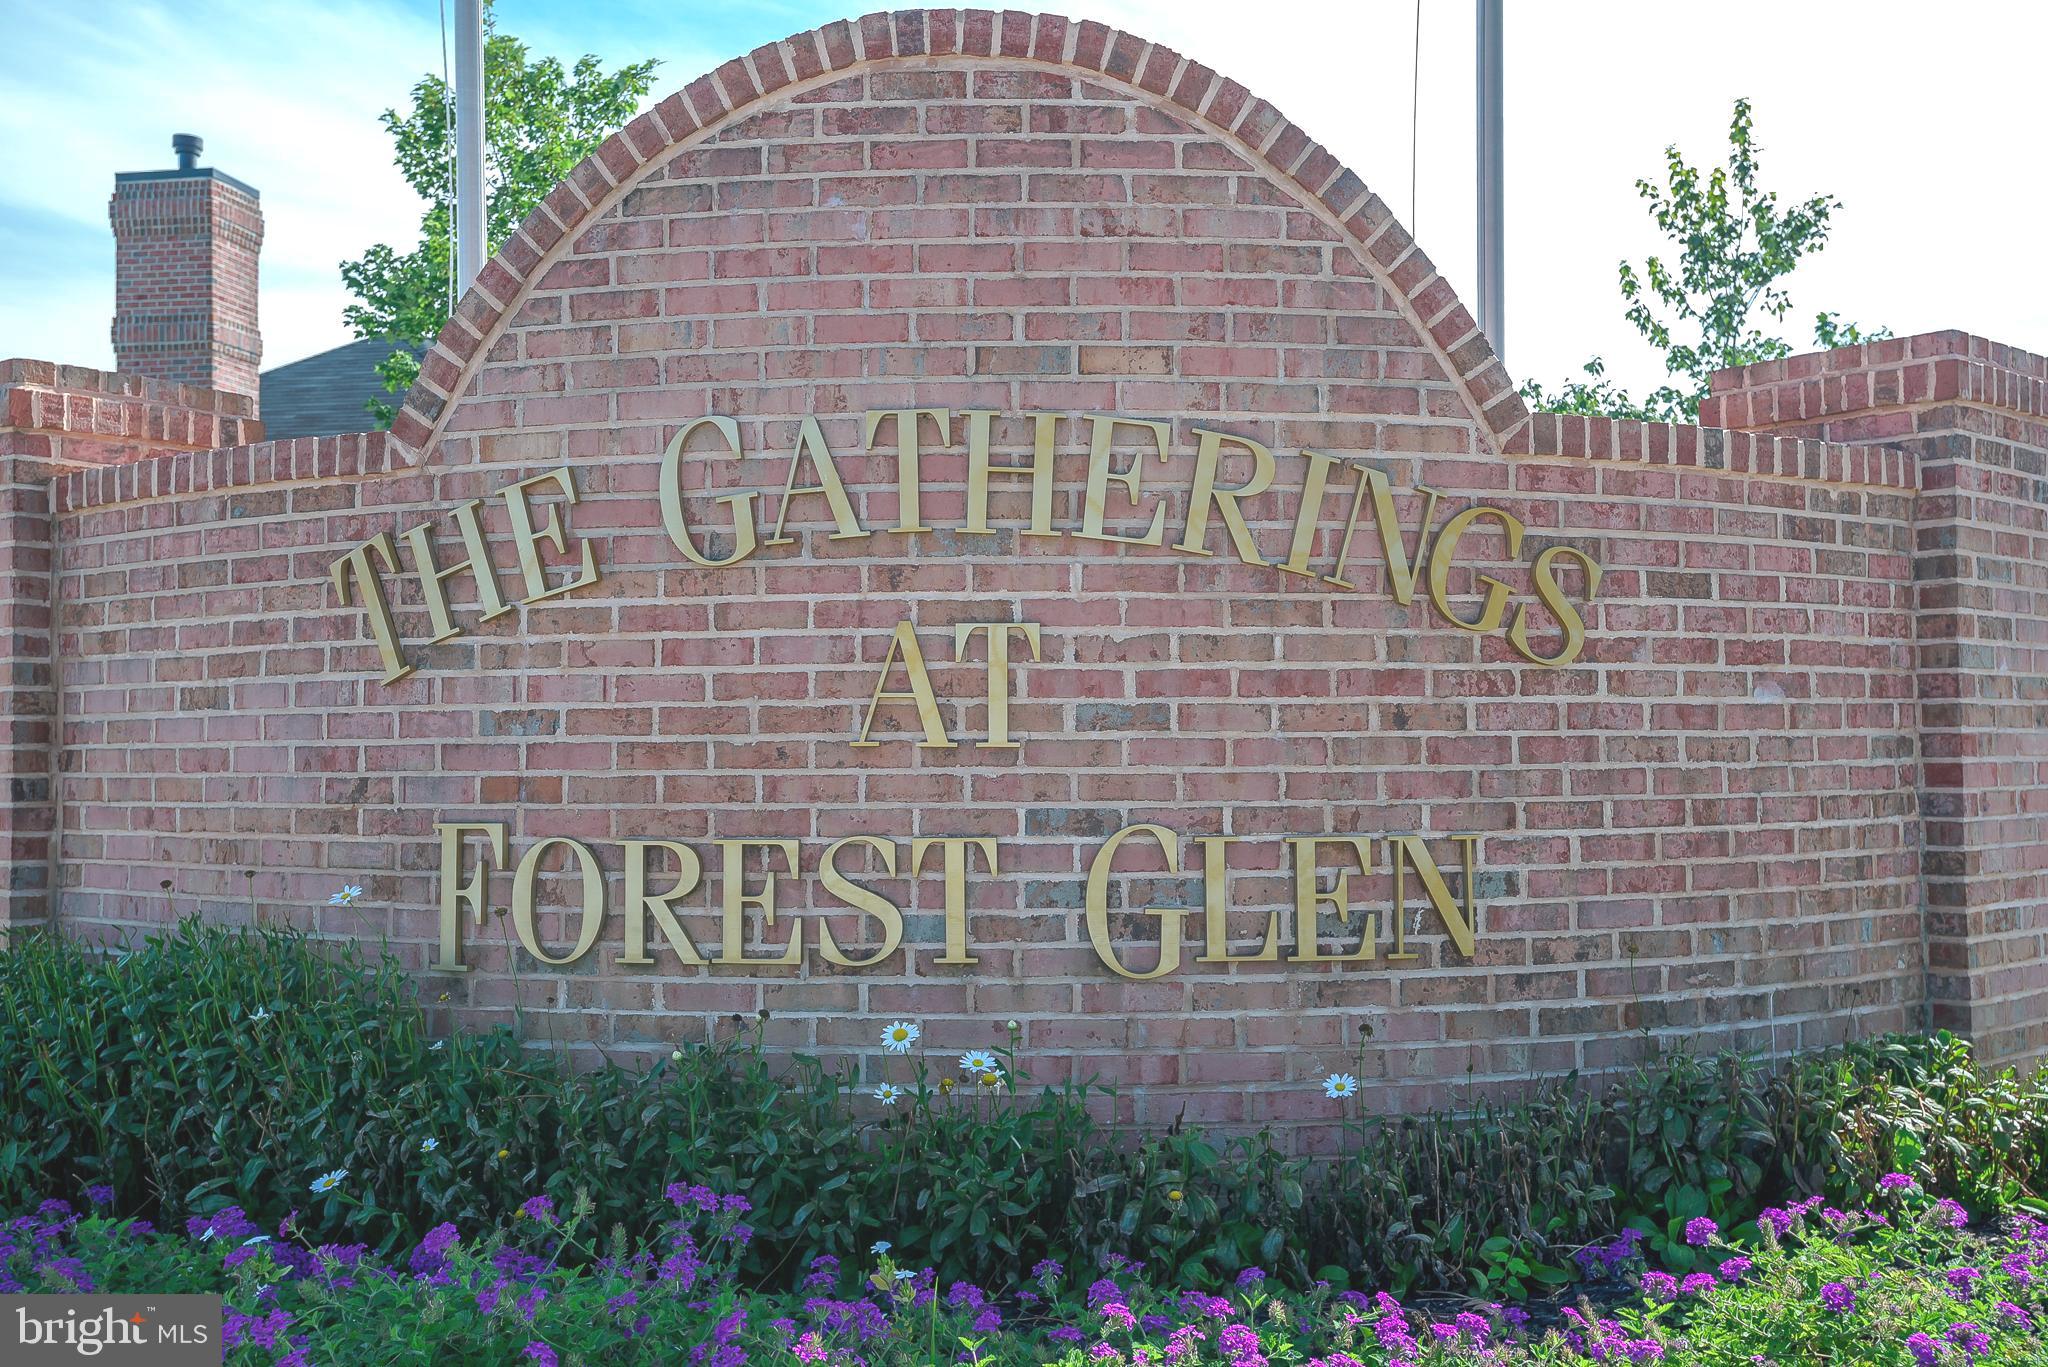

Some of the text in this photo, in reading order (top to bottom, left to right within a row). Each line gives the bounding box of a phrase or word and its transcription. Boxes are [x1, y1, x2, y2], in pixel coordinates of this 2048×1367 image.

[329, 408, 1604, 687] THE GATHERINGS
[850, 620, 1042, 749] AT
[432, 821, 1478, 981] FOREST GLEN
